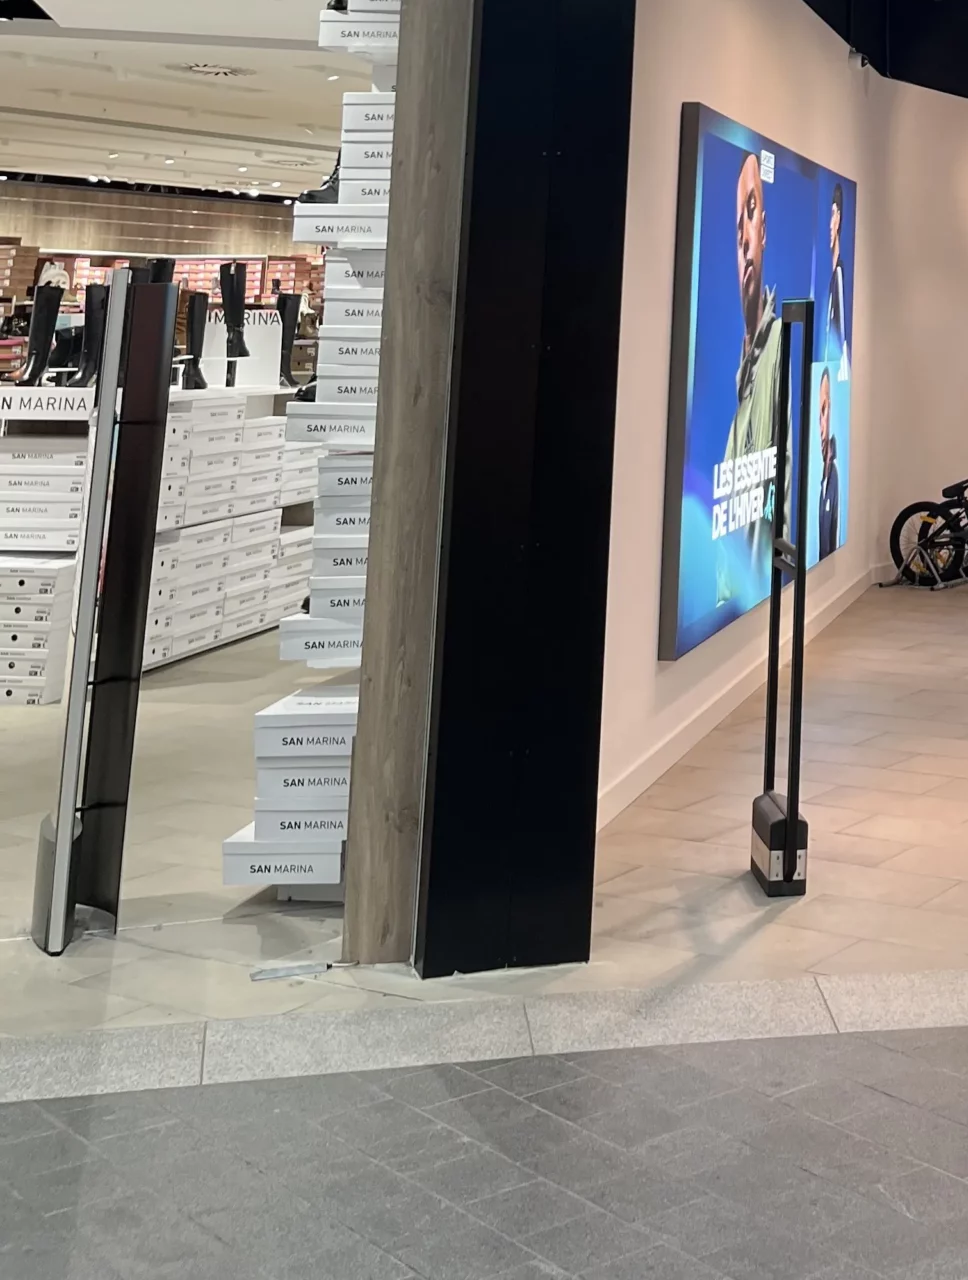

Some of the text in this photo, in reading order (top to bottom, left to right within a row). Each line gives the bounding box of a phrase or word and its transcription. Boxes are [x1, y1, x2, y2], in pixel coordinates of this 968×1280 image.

[340, 30, 398, 39] SAN MARINA
[364, 113, 384, 121] SAN
[364, 151, 384, 159] SAN
[361, 188, 381, 196] SAN
[315, 225, 372, 234] SAN MARINA
[344, 270, 385, 279] SAN MAR
[344, 308, 364, 317] SAN
[214, 311, 281, 326] MRINA
[338, 347, 380, 356] SAN MAR
[337, 386, 379, 395] SAN MAR
[19, 396, 87, 411] MARINA
[306, 424, 366, 433] SAN MARINA
[713, 445, 778, 500] LES ESSENTIE
[337, 477, 358, 486] SAN
[335, 517, 356, 526] SAN
[711, 500, 728, 541] DE
[332, 557, 353, 567] SAN
[330, 599, 350, 608] SAN
[304, 641, 325, 650] SAN
[282, 736, 346, 746] SAN MARINA
[283, 777, 348, 788] SAN MARINA
[279, 820, 344, 830] SAN MARINA
[249, 864, 314, 874] SAN MARINA
